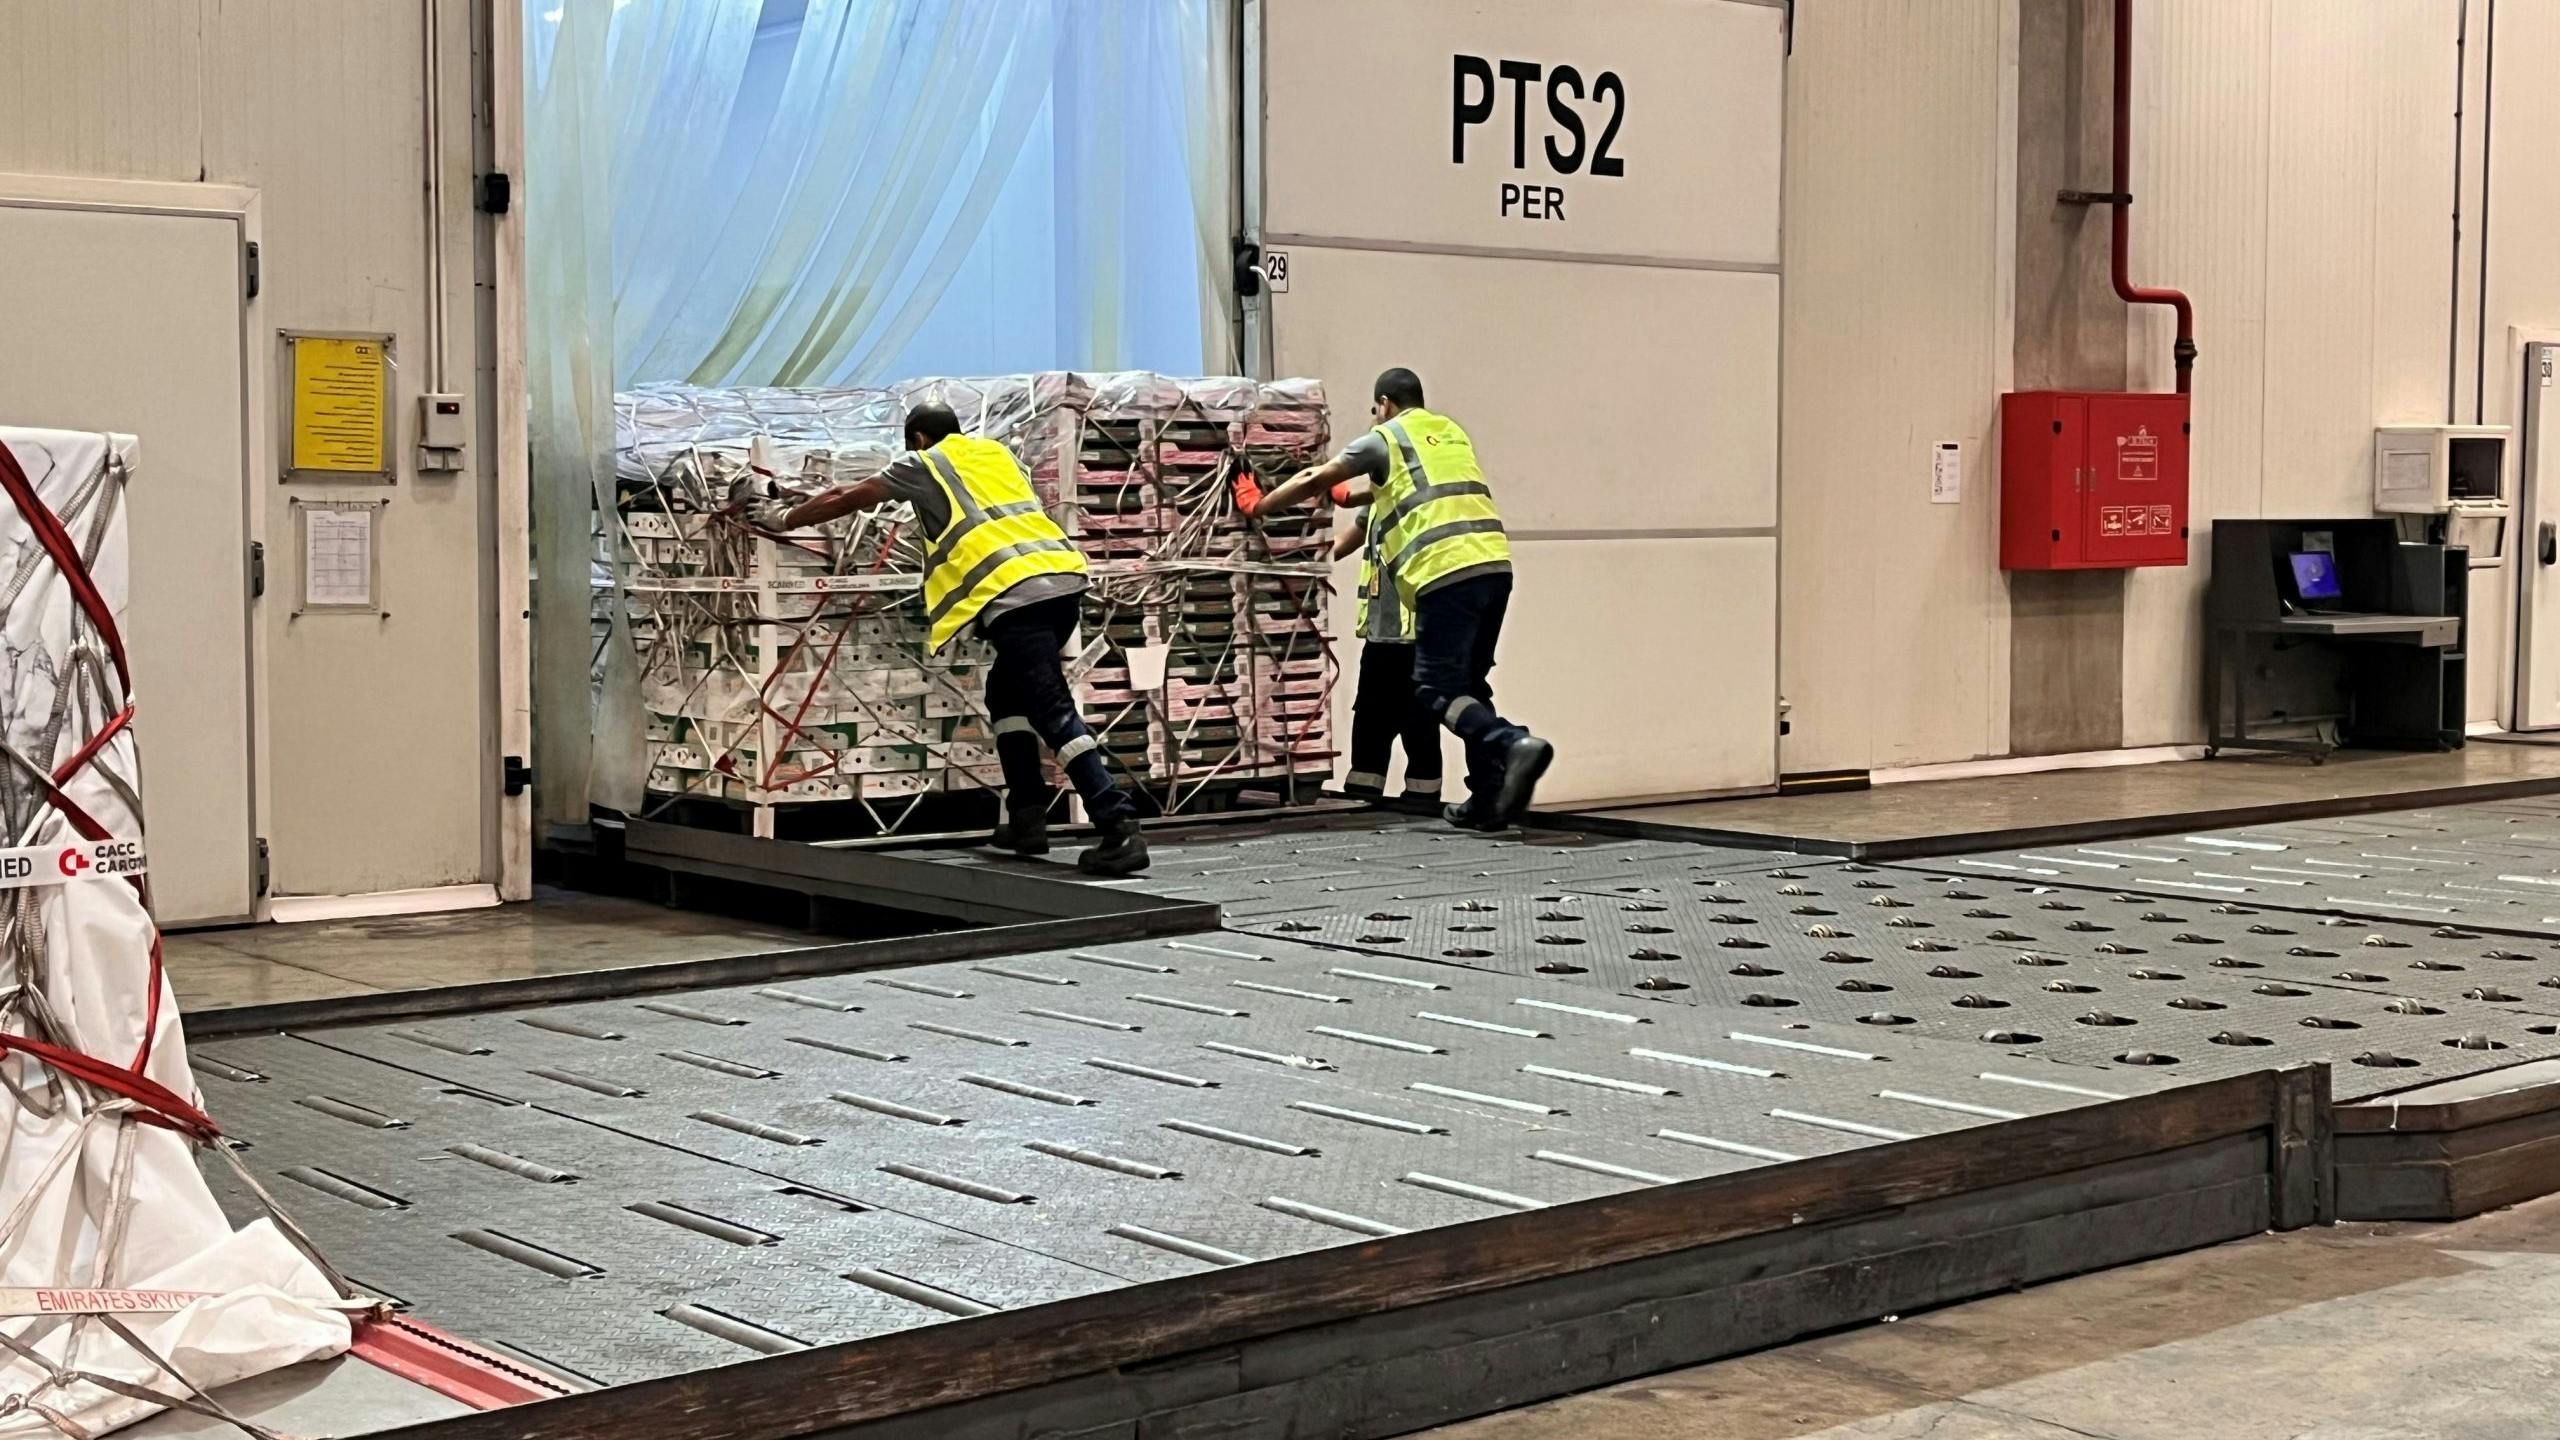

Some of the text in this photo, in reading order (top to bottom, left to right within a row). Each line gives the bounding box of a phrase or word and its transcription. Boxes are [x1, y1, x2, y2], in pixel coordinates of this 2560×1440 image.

[1453, 54, 1625, 177] PTS2
[1501, 183, 1565, 221] PER
[1268, 255, 1287, 280] 29
[95, 842, 136, 858] CACC
[0, 857, 32, 879] ED
[36, 1291, 136, 1312] EMIRATES
